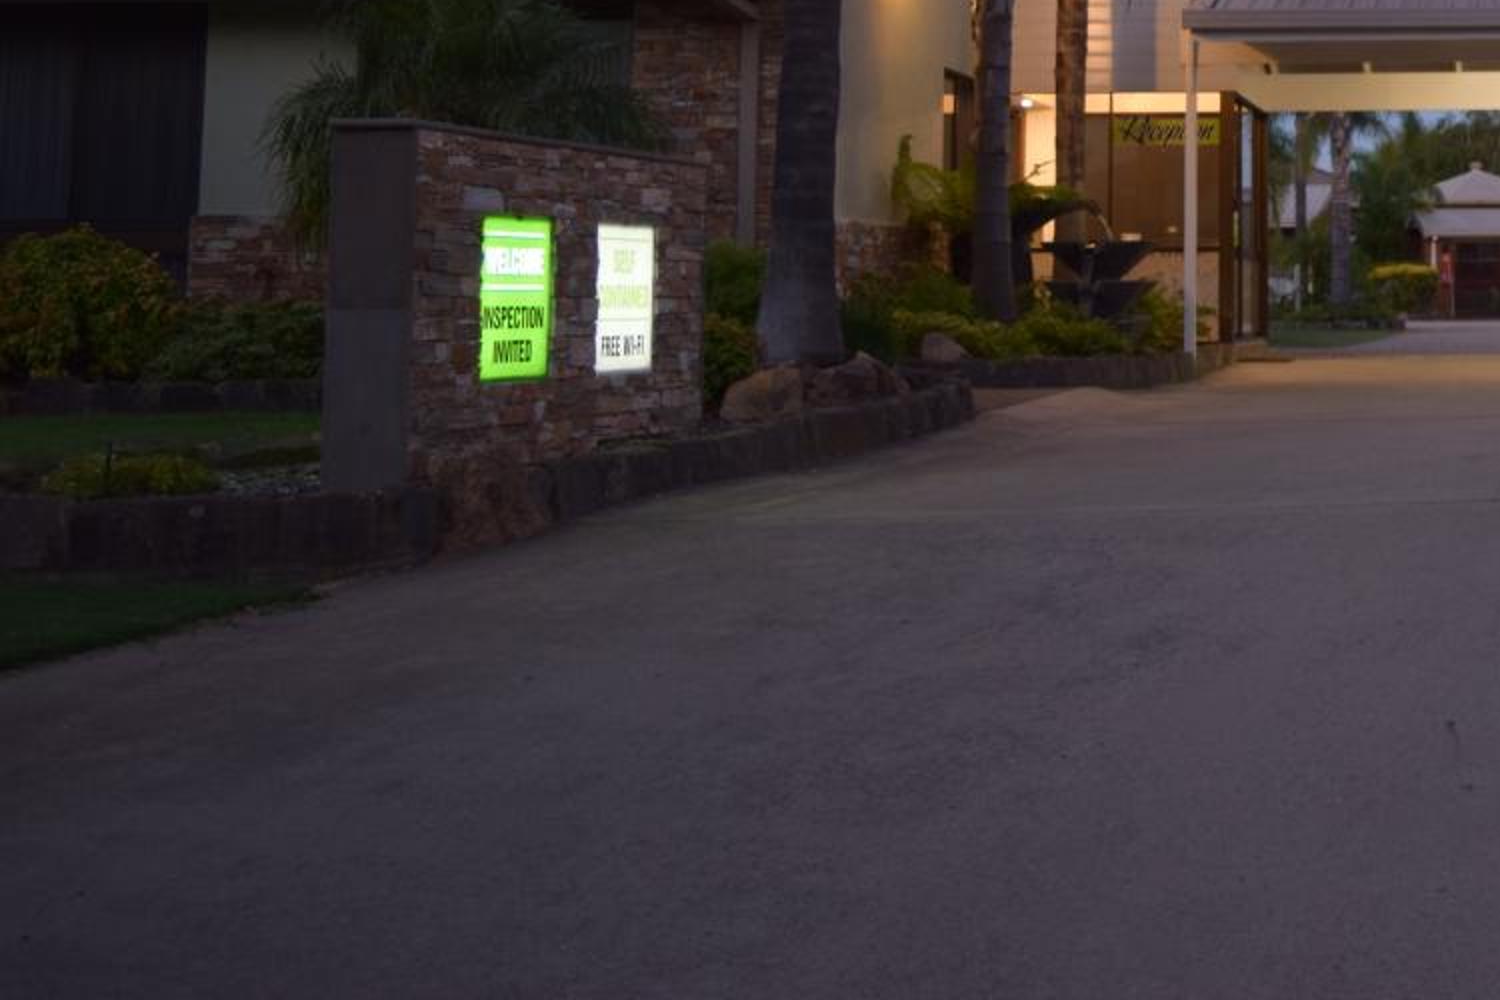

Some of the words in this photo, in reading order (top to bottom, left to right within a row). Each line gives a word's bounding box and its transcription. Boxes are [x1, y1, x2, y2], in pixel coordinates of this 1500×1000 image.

[483, 305, 545, 329] INSPECTION
[493, 340, 533, 364] INVITED
[601, 335, 621, 357] FREE
